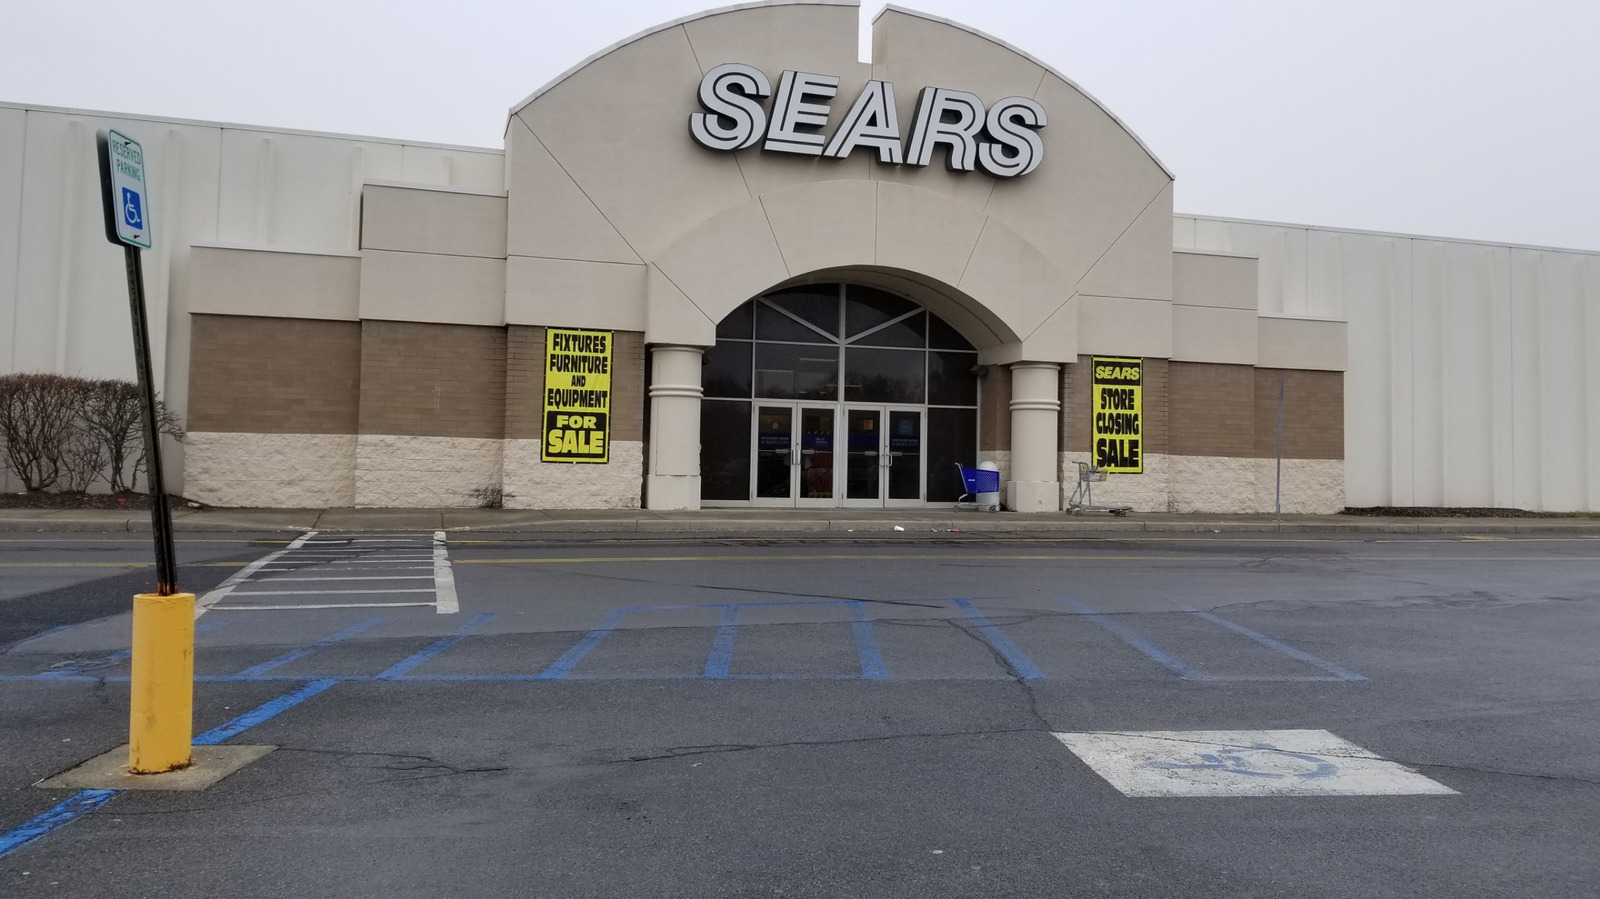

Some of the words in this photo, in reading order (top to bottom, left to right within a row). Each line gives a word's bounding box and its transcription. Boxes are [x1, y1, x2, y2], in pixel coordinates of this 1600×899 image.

[688, 63, 1048, 177] SEARS
[112, 140, 141, 165] RESERVED
[116, 159, 141, 181] PARKING
[552, 333, 606, 353] FIXTURES
[550, 354, 608, 374] FURNITURE
[1095, 366, 1140, 380] SEARS
[571, 375, 586, 387] AND
[547, 388, 608, 409] EQUIPMENT
[1100, 388, 1135, 410] STORE
[556, 415, 597, 429] FOR
[1096, 412, 1139, 435] CLOSING
[548, 429, 604, 454] SALE
[1096, 438, 1139, 468] SALE
